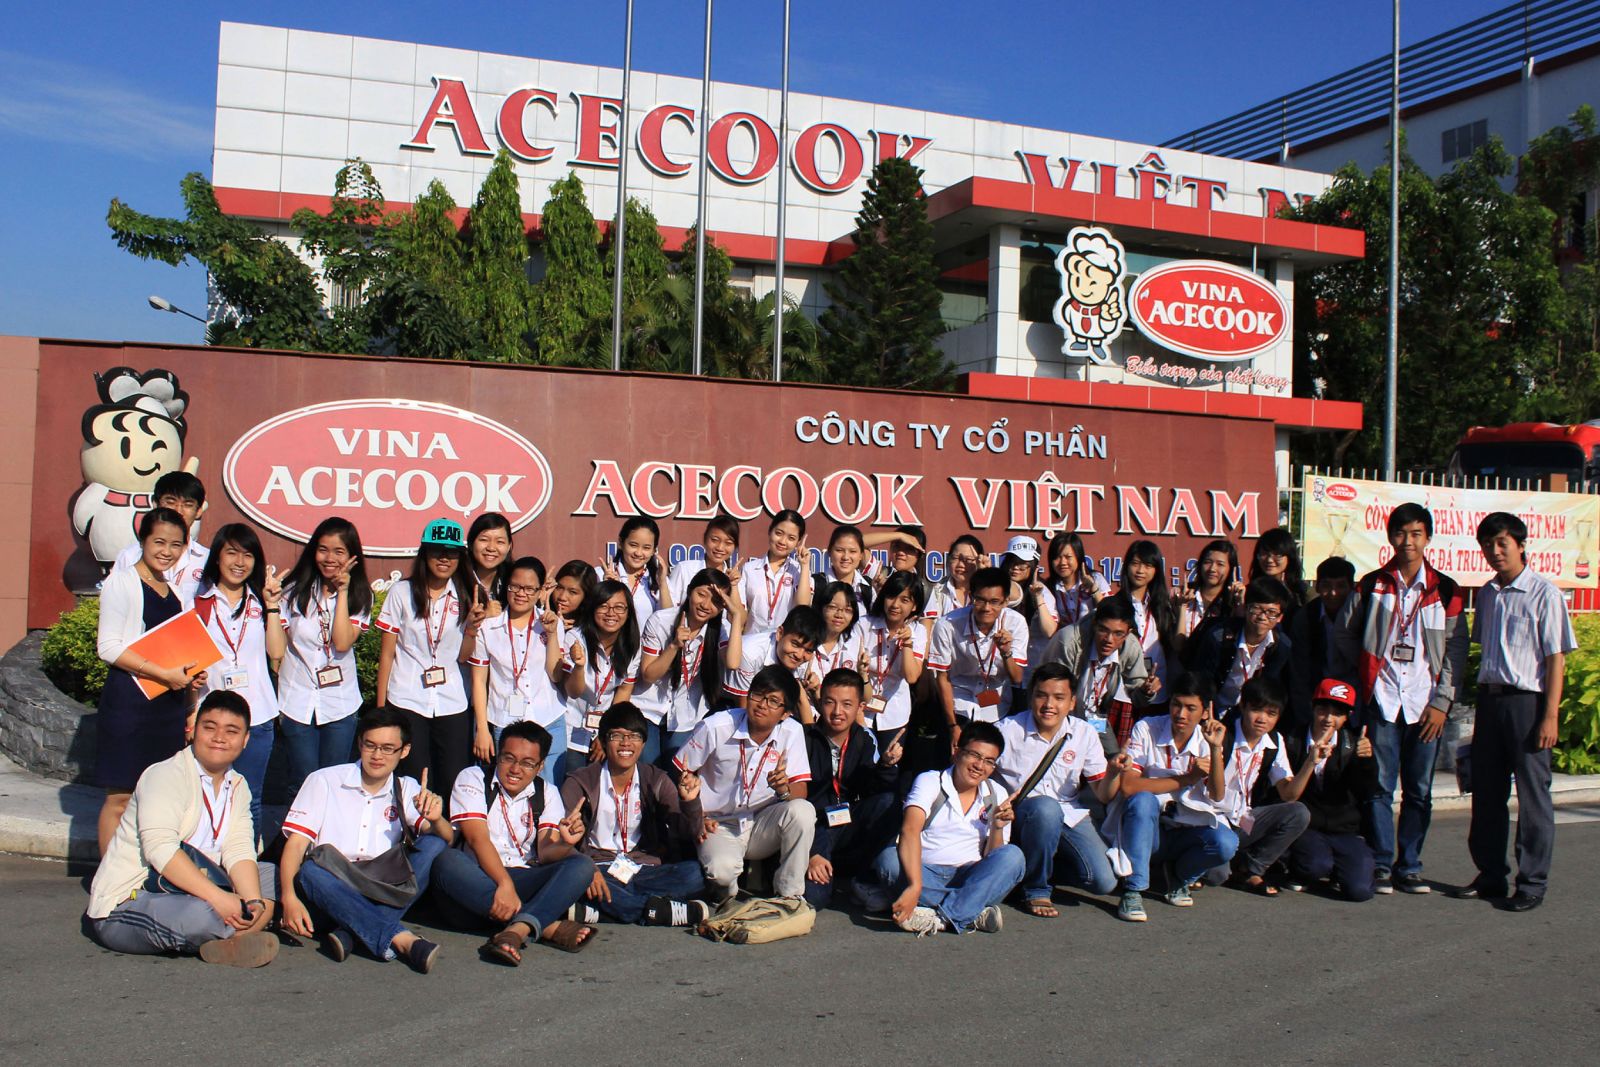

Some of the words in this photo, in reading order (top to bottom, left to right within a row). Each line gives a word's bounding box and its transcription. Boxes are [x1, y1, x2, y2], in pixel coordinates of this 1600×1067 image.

[1181, 280, 1245, 305] VINA
[1147, 300, 1275, 337] ACECOOK
[1198, 363, 1223, 382] của
[327, 427, 460, 460] VINA
[796, 411, 896, 448] CÔNG
[908, 423, 950, 450] TY
[963, 417, 1010, 453] CỔ
[1025, 424, 1108, 459] PHẦN
[256, 464, 527, 515] ACECOOK
[571, 459, 925, 528] ACECOOK
[948, 470, 1105, 540] VIỆT
[1114, 484, 1261, 540] NAM
[432, 525, 461, 543] HEAD
[1365, 496, 1396, 532] CÔN
[1433, 496, 1465, 536] PHẦN
[1544, 512, 1567, 540] NAM
[1012, 542, 1037, 551] EDWIN
[1437, 542, 1454, 571] ĐÁ
[1538, 551, 1563, 577] 2013
